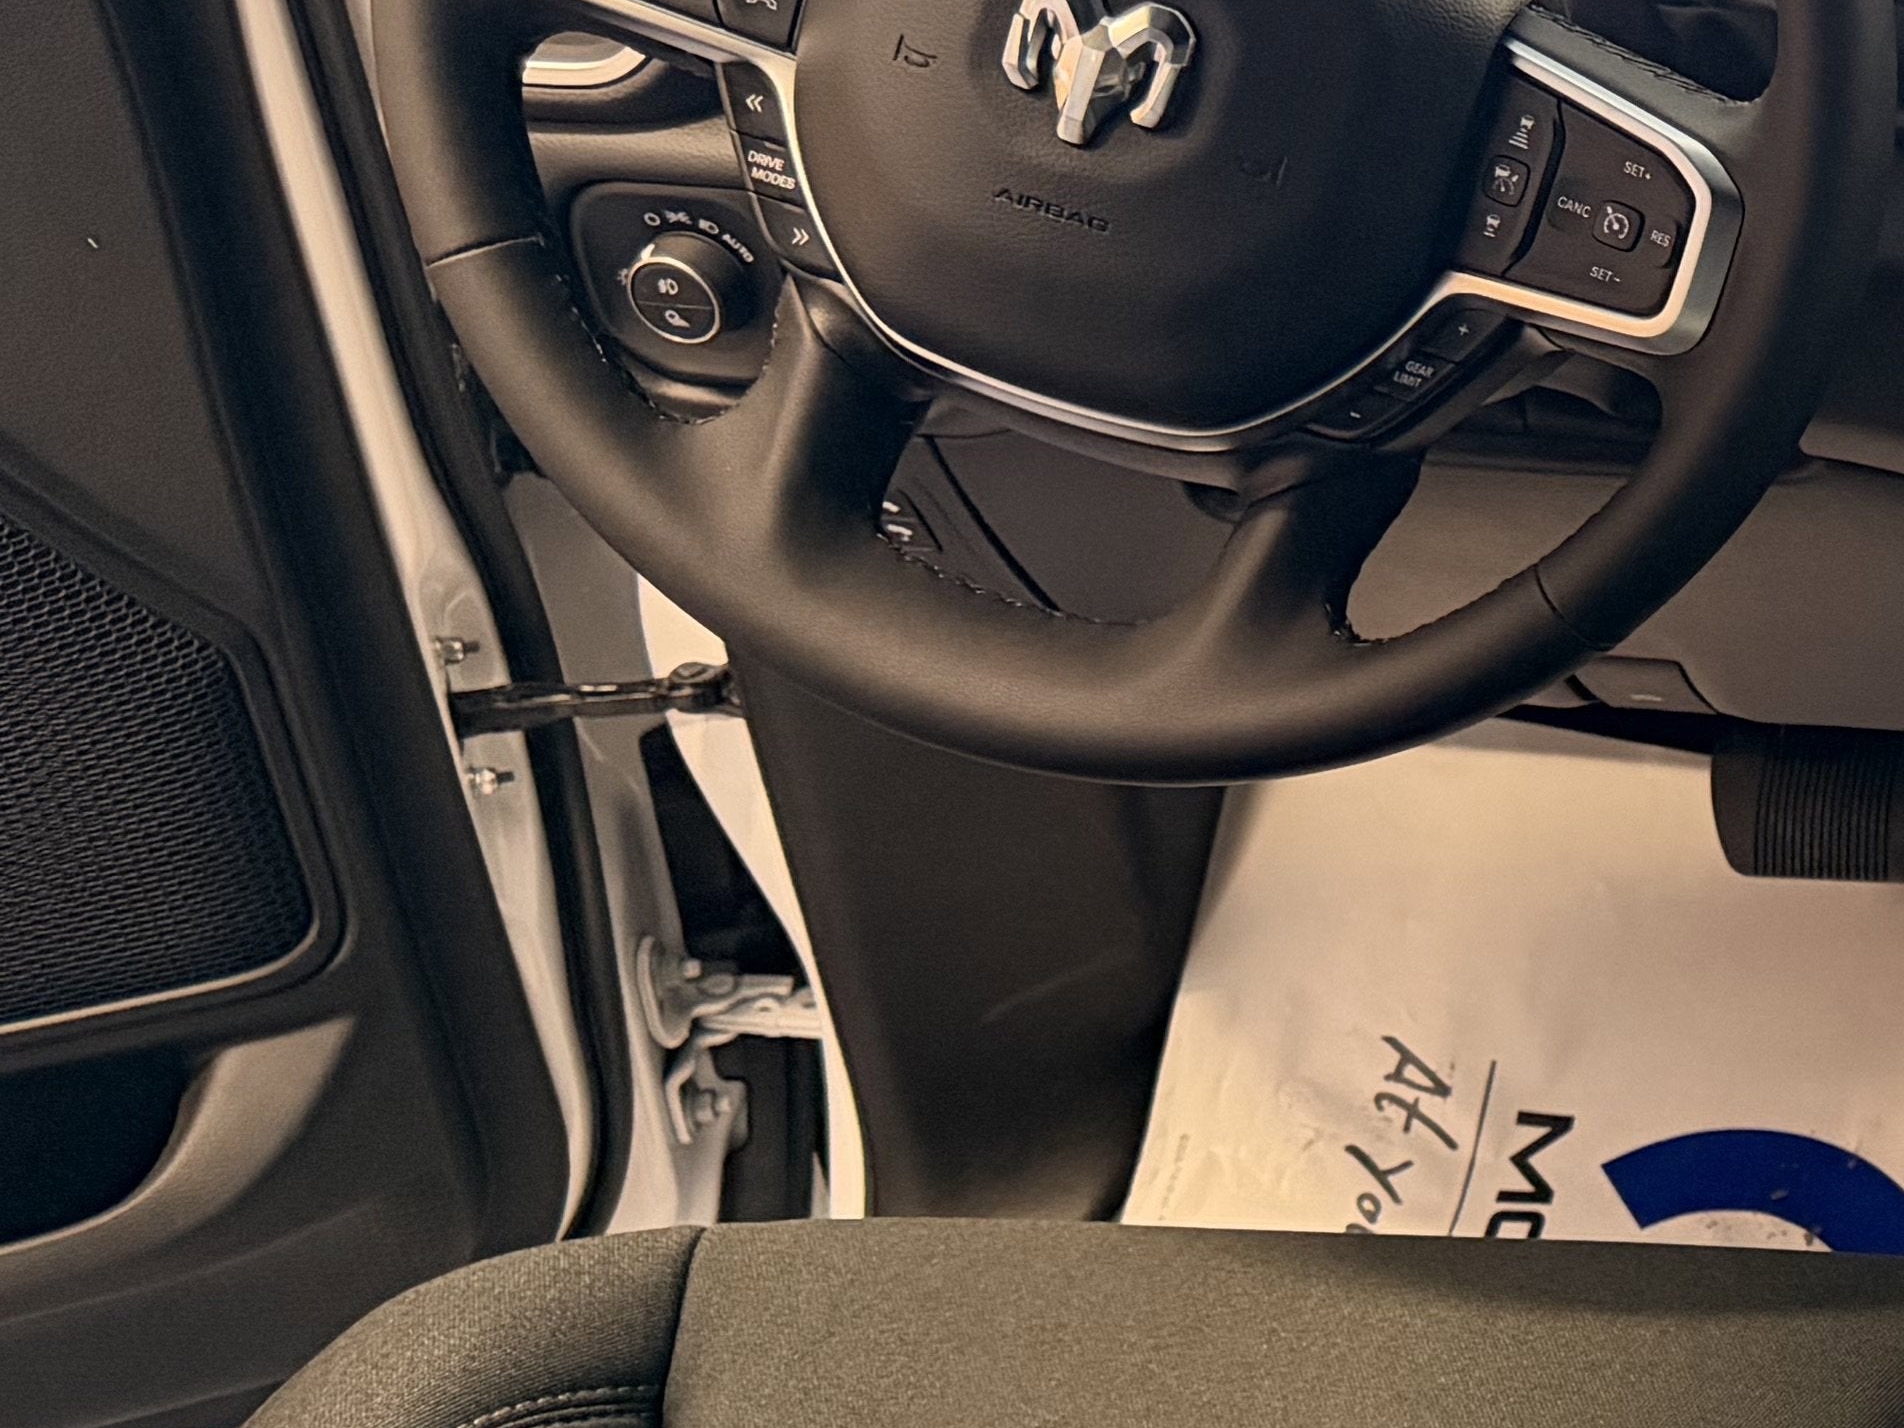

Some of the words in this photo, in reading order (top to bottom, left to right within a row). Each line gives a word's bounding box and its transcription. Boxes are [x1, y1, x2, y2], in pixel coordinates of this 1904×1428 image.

[748, 150, 786, 170] DRIVE
[751, 166, 797, 190] MODES
[994, 188, 1110, 233] AIRBAG
[1557, 196, 1592, 218] CANC
[722, 233, 754, 263] AUTO
[1650, 229, 1672, 248] RES
[1393, 371, 1423, 388] LIMIT
[1405, 360, 1435, 378] GEAR
